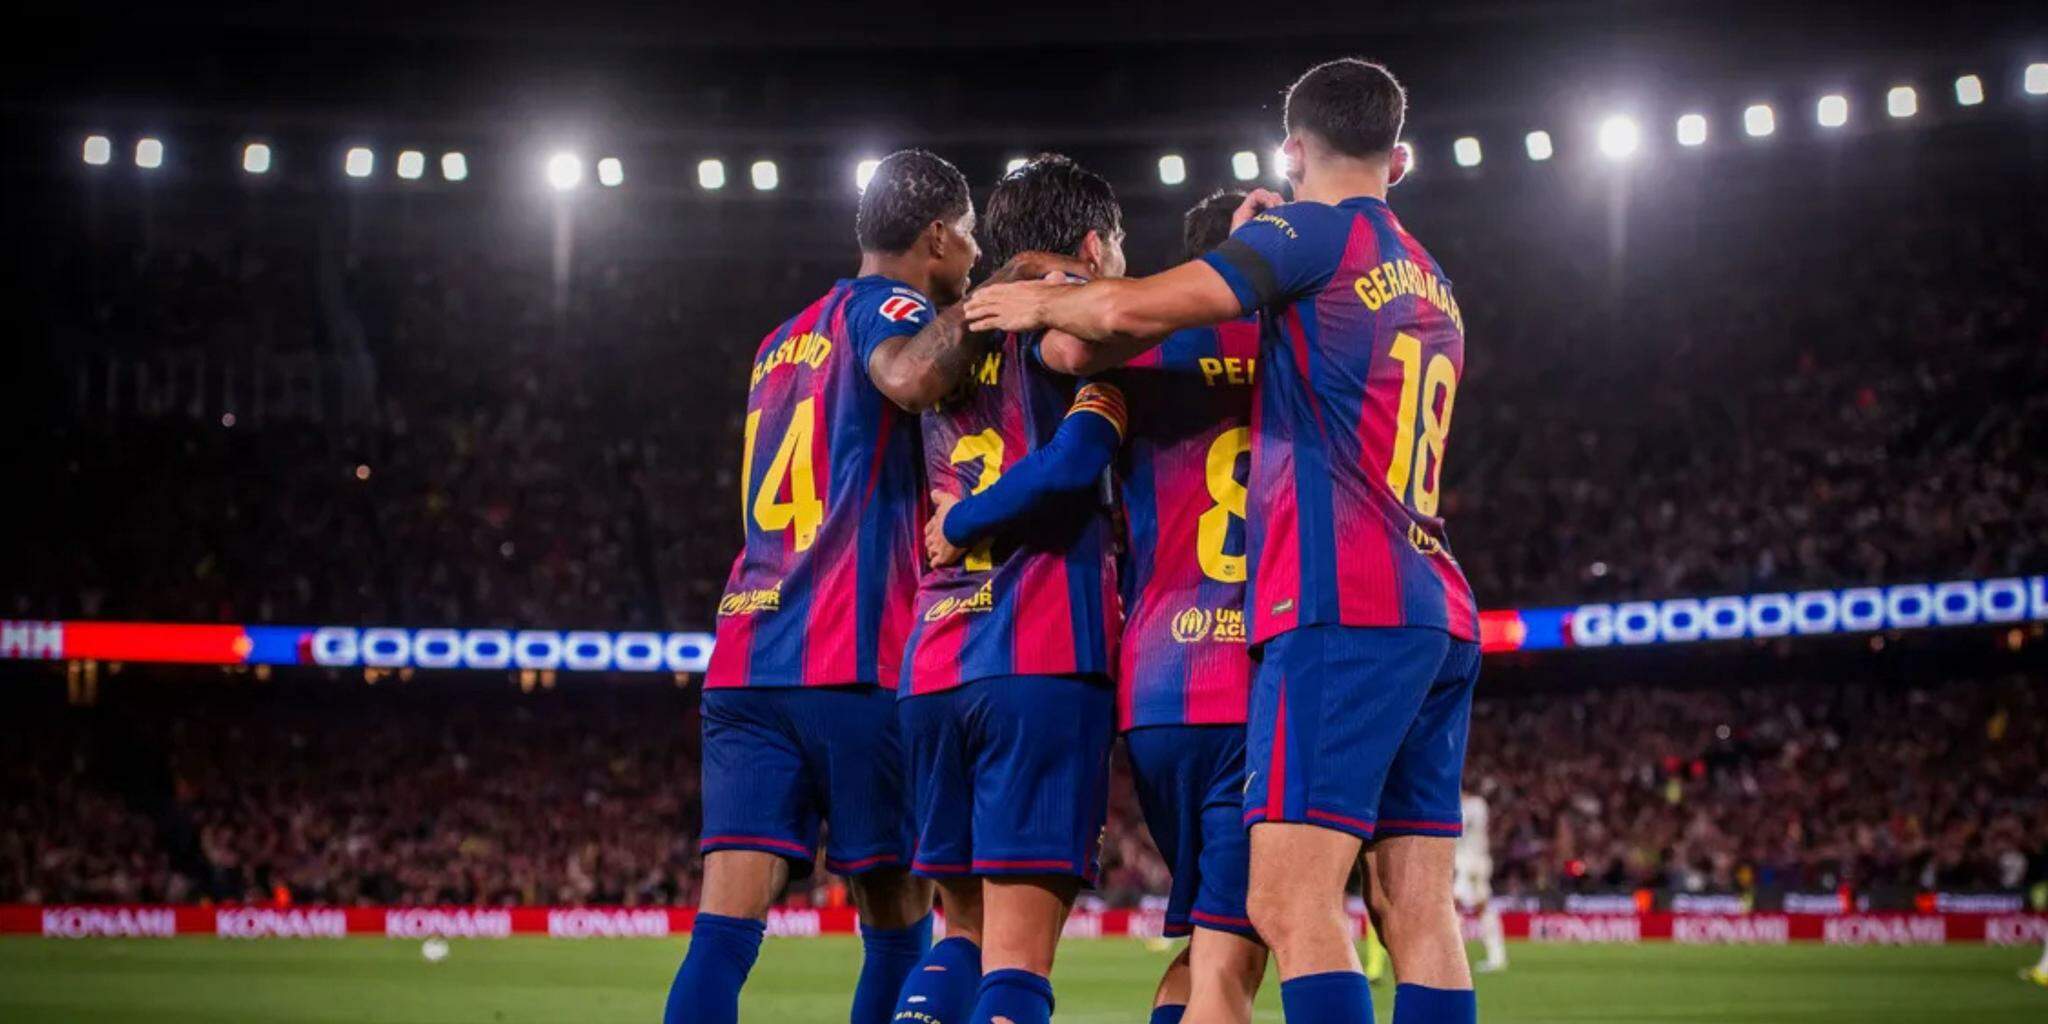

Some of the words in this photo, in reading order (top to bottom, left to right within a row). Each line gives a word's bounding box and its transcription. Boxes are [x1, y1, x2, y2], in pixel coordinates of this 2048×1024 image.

[1388, 332, 1456, 518] 18
[741, 397, 823, 552] 14
[1197, 426, 1251, 584] 8
[42, 907, 176, 938] KONAMI
[216, 907, 347, 938] KONAMI
[385, 907, 511, 938] KONAMI
[547, 907, 668, 938] KONAMI
[1822, 914, 1946, 945] KONAMI
